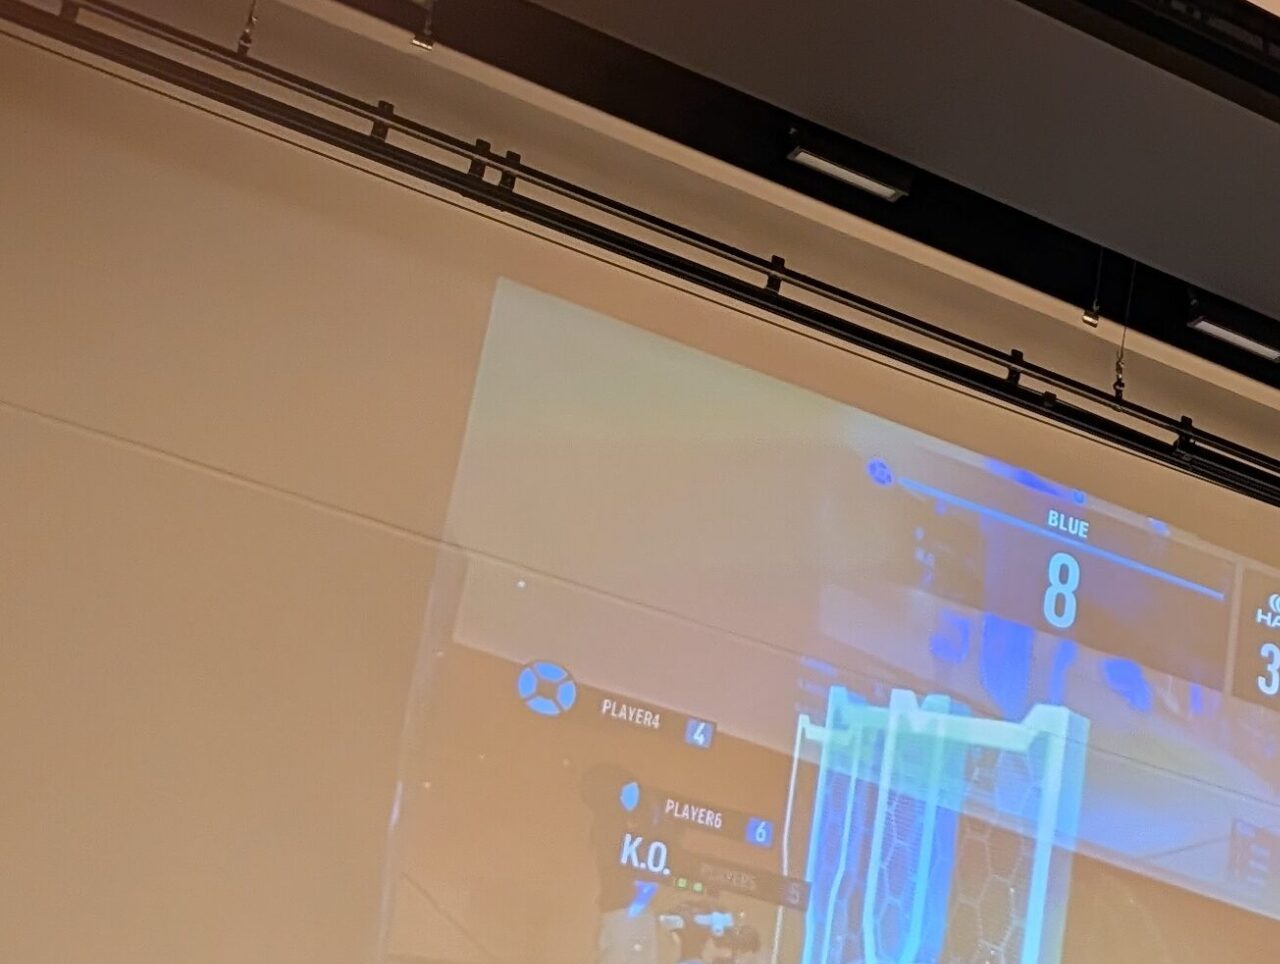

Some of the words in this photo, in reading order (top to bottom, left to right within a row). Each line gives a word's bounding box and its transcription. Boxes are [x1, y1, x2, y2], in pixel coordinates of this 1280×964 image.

[1047, 509, 1089, 538] BLUE
[1043, 552, 1080, 629] 8
[602, 699, 661, 729] PLAYER4
[692, 722, 705, 746] 4
[665, 799, 723, 829] PLAYER6
[755, 821, 767, 843] 6
[620, 833, 671, 876] K.O.
